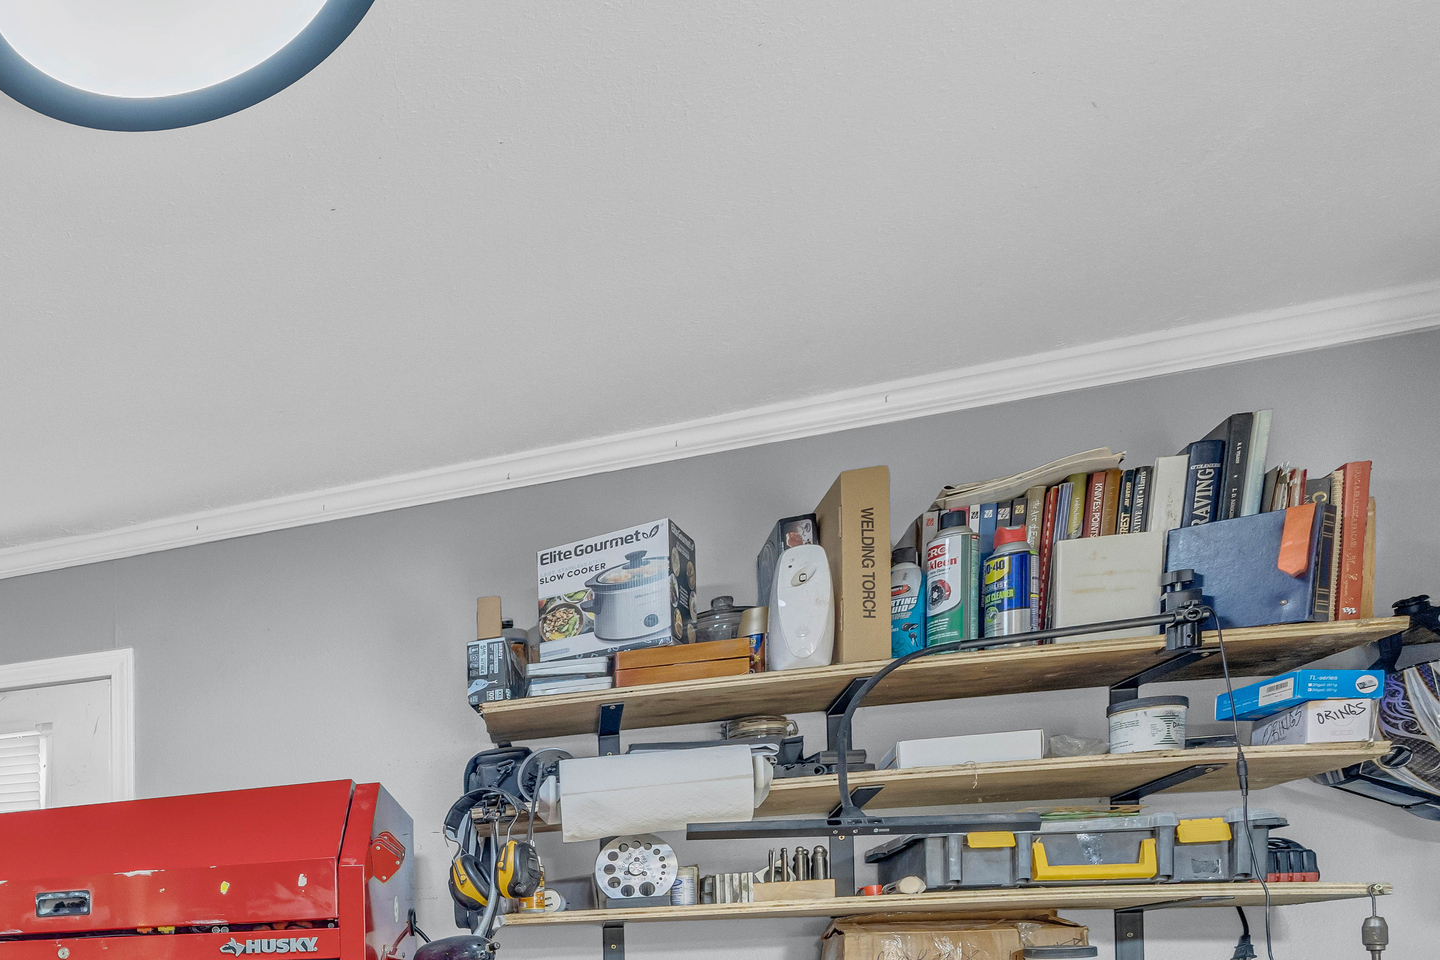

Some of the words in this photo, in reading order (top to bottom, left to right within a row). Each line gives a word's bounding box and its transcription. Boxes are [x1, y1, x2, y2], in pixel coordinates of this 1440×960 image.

[1092, 483, 1103, 512] KNIVES:
[1136, 494, 1144, 508] ART
[540, 550, 572, 566] Elite
[574, 530, 641, 557] Gourmet
[860, 507, 875, 569] WELDING
[540, 573, 564, 585] SLOW
[567, 562, 606, 578] COOKER
[862, 572, 876, 619] TORCH
[1316, 702, 1366, 724] ORINGS
[245, 937, 318, 954] HUSKY
